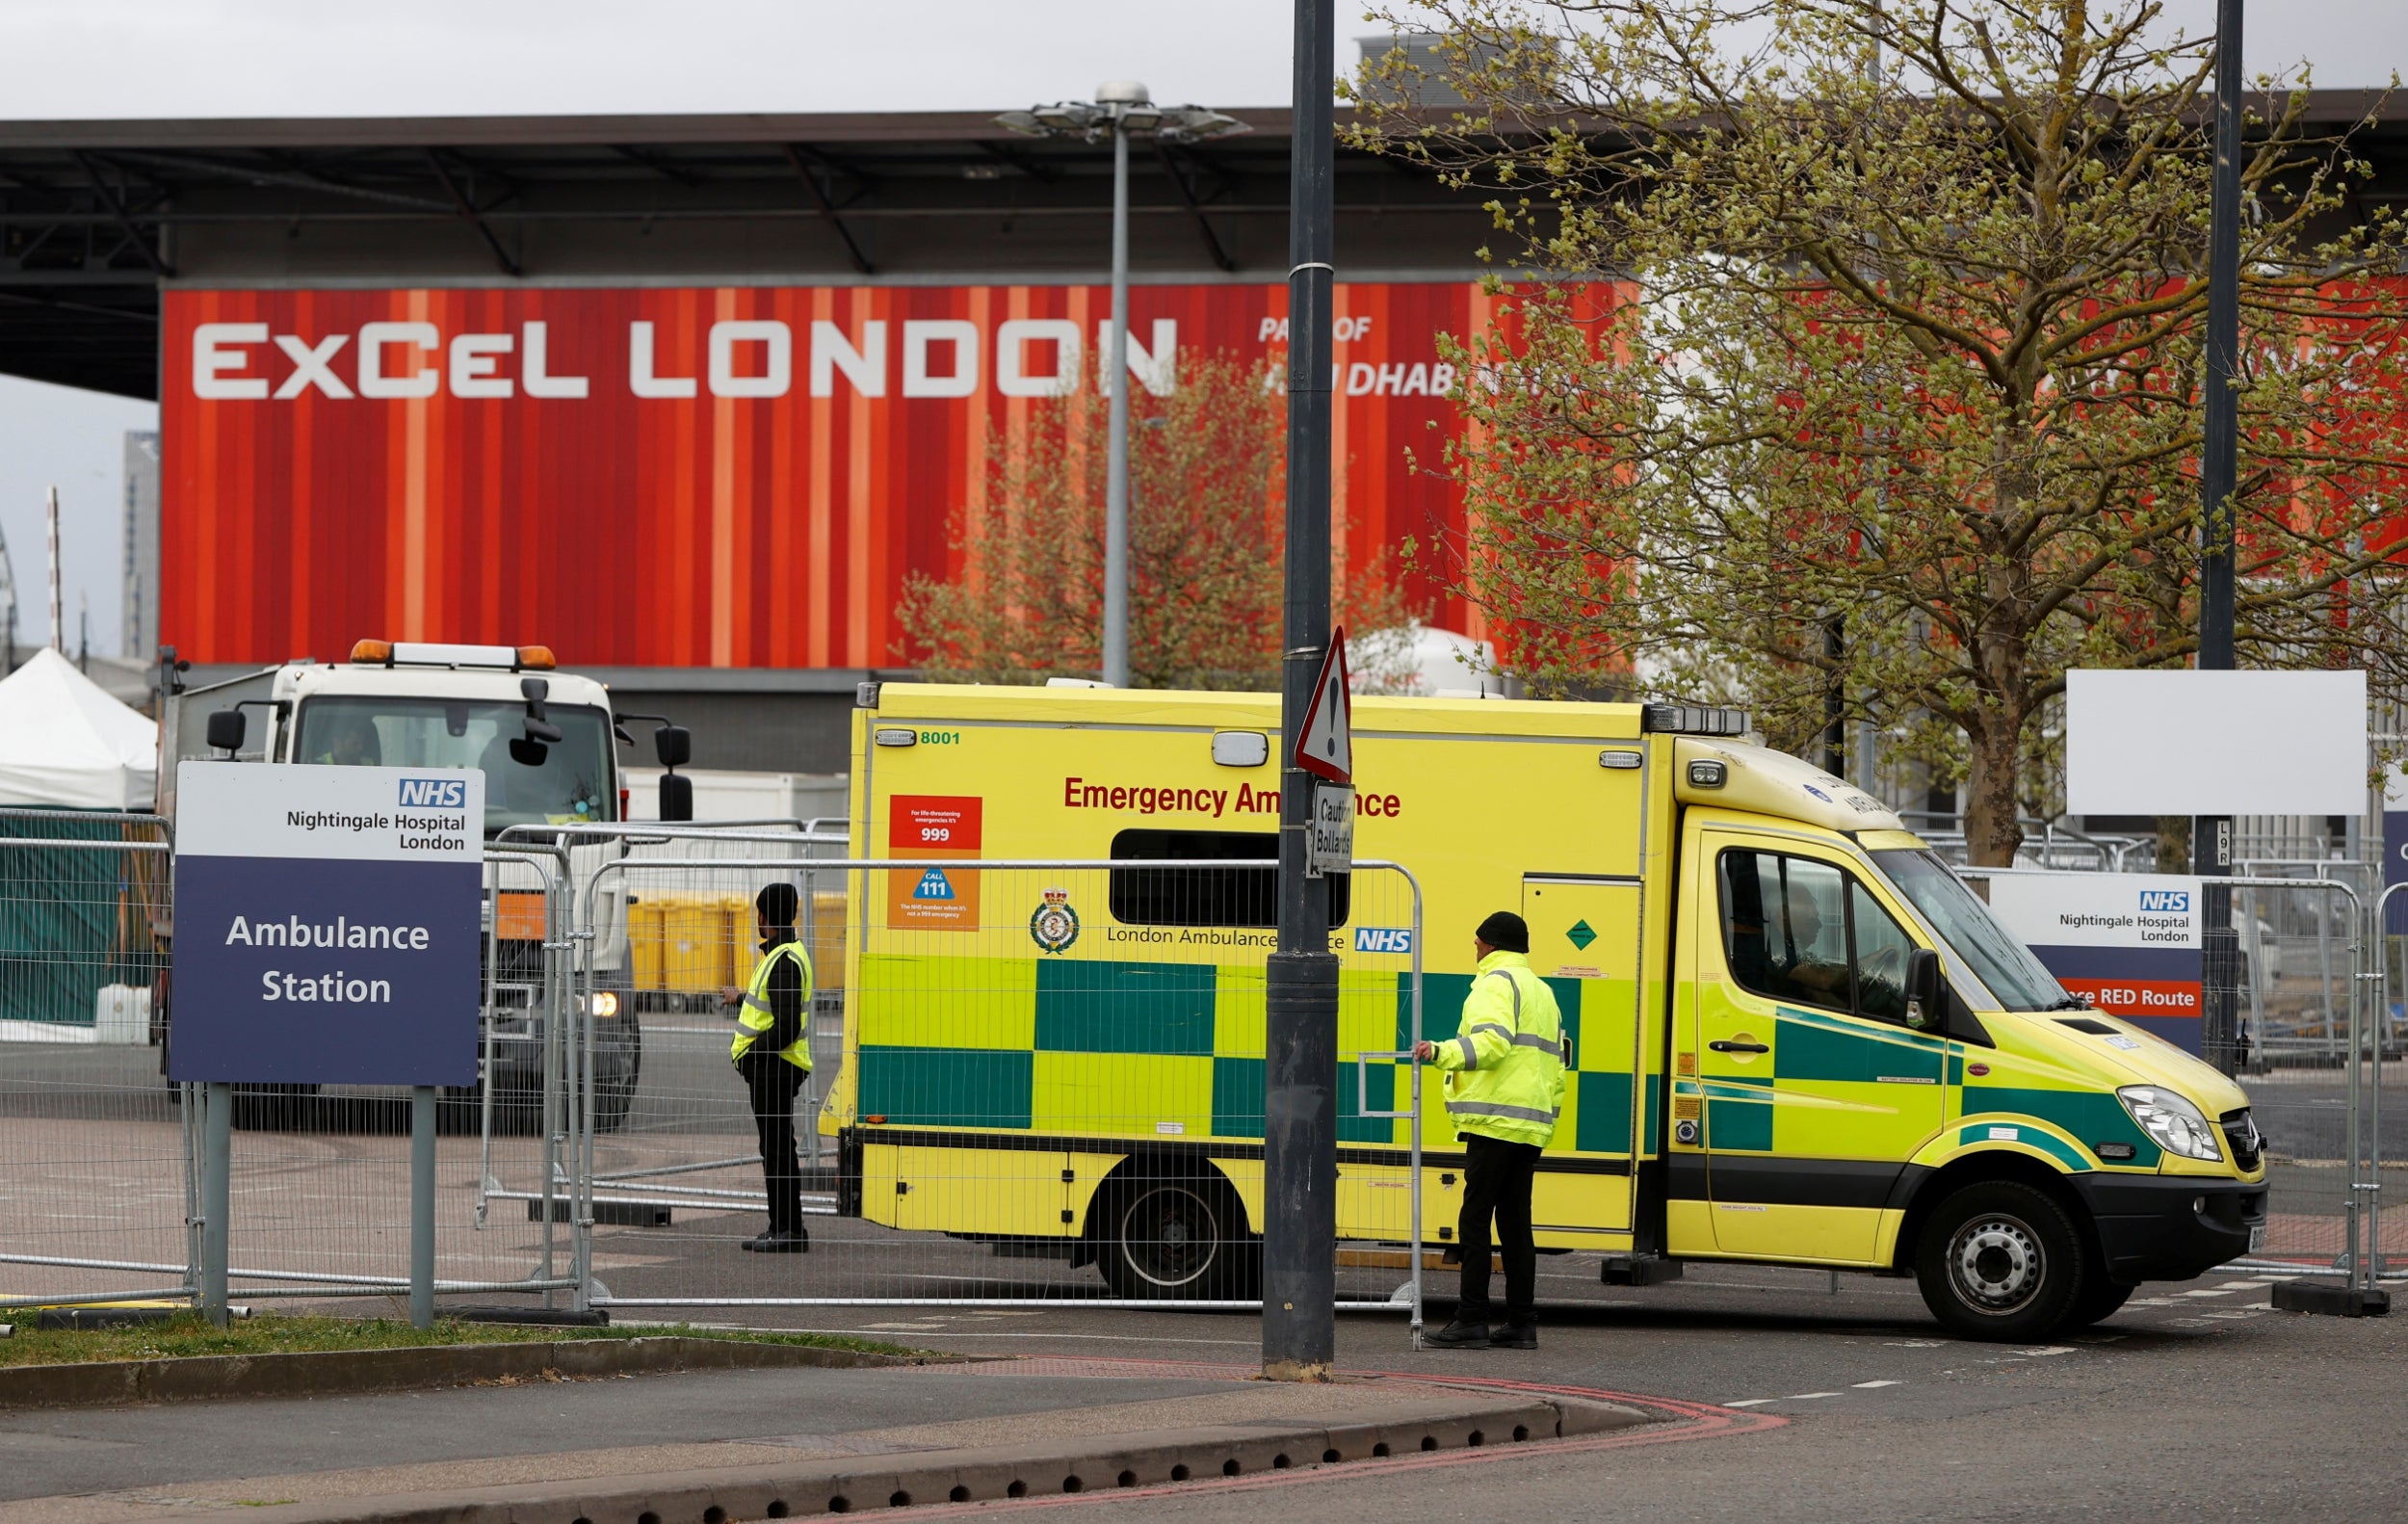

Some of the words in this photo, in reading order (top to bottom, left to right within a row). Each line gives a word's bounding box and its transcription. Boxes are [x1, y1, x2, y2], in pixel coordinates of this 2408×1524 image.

[1333, 316, 1373, 343] OF
[629, 319, 1177, 398] LONDON
[921, 731, 960, 745] 8001
[400, 779, 464, 807] NHS
[1064, 776, 1228, 818] Emergency
[1321, 797, 1351, 823] Caution
[287, 811, 389, 831] Nightingale
[395, 814, 465, 832] Hospital
[400, 834, 464, 851] London
[921, 827, 950, 842] 999
[1316, 828, 1349, 854] Bollards
[921, 881, 946, 896] 111
[2140, 891, 2188, 911] NHS
[225, 914, 430, 950] Ambulance
[2059, 914, 2133, 929] Nightingale
[2137, 916, 2189, 930] Hospital
[1108, 927, 1173, 943] London
[1179, 929, 1278, 947] Ambulance
[1355, 930, 1411, 952] NHS
[2141, 930, 2189, 942] London
[262, 970, 391, 1003] Station
[2101, 988, 2136, 1005] RED
[2141, 989, 2195, 1007] Route
